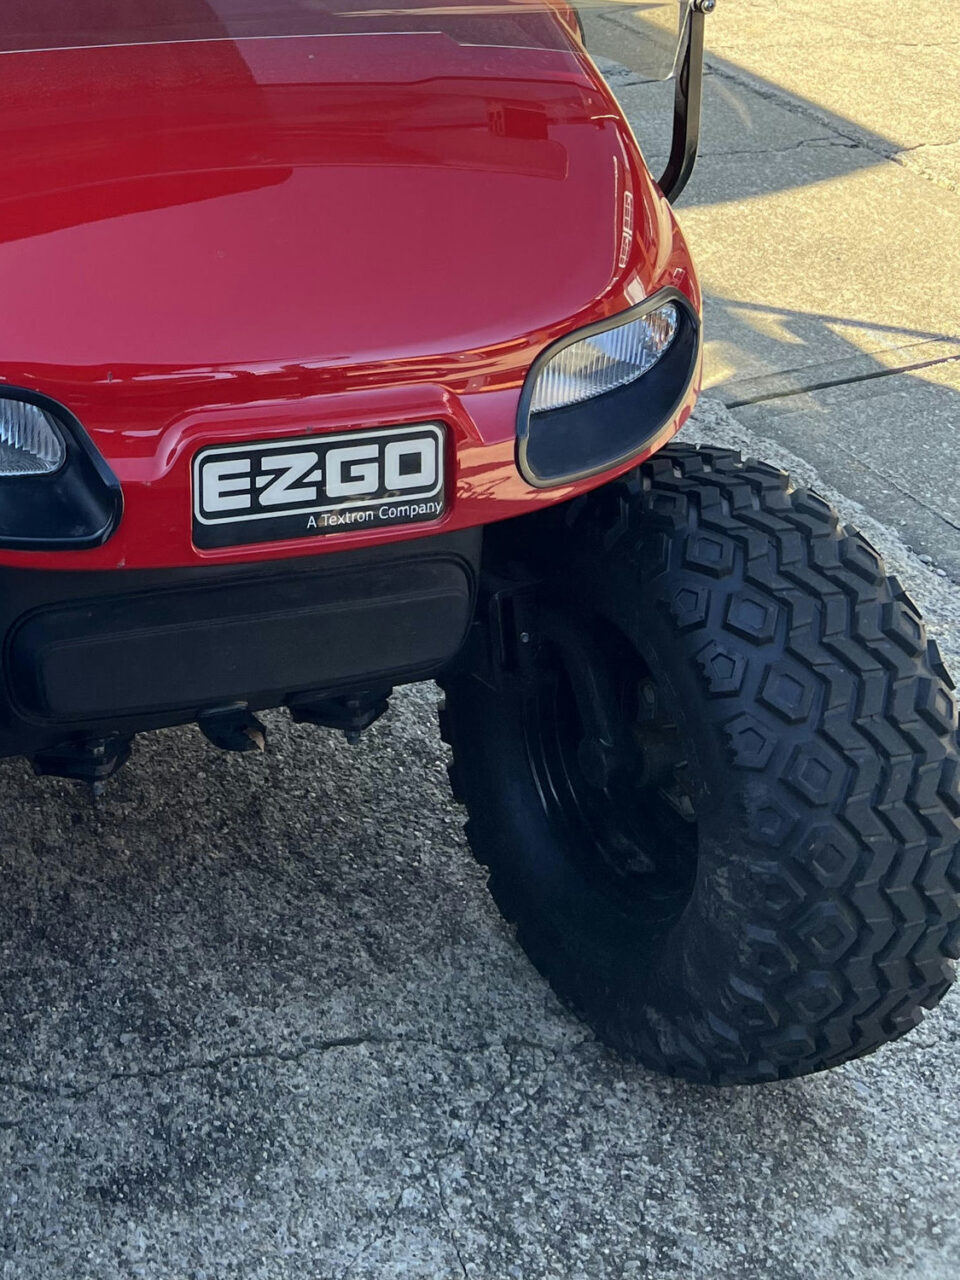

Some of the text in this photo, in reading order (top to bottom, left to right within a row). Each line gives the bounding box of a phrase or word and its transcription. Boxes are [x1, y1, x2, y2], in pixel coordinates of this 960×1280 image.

[306, 501, 444, 529] A Textron Company
